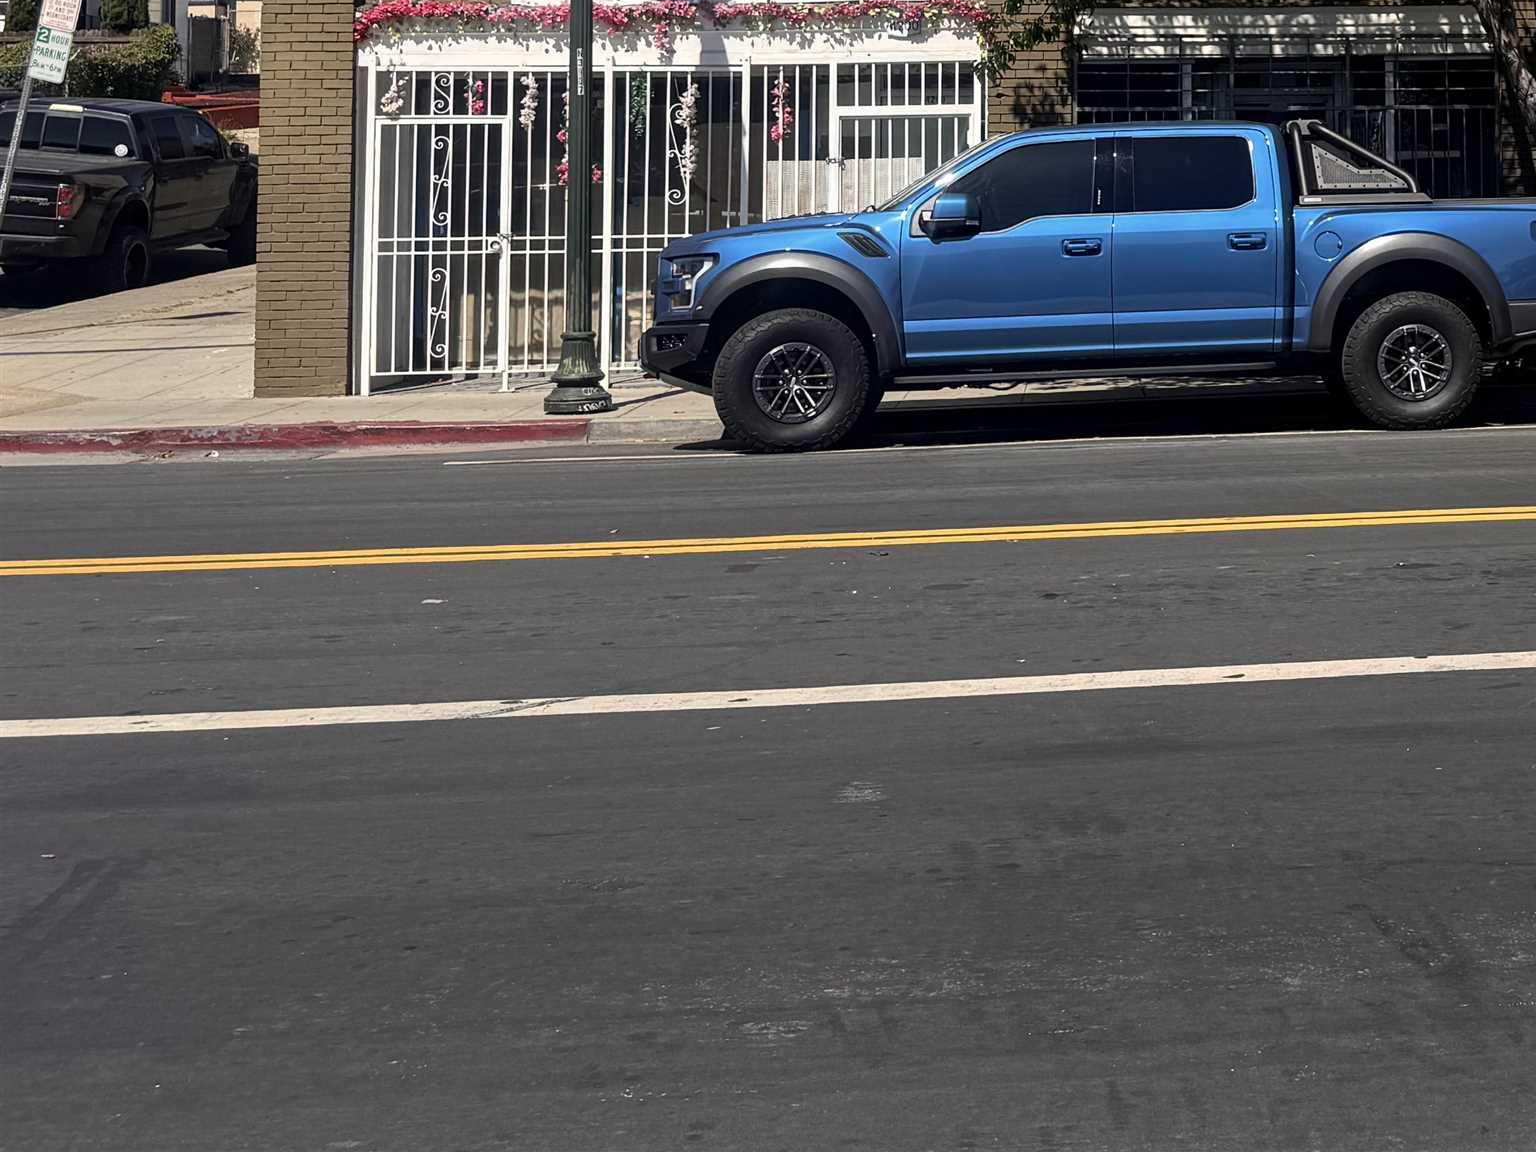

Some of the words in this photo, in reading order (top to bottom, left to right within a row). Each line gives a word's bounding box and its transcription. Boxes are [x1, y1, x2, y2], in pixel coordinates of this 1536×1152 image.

[40, 28, 49, 41] 2
[51, 35, 70, 46] HOUR
[35, 45, 67, 62] PARKING
